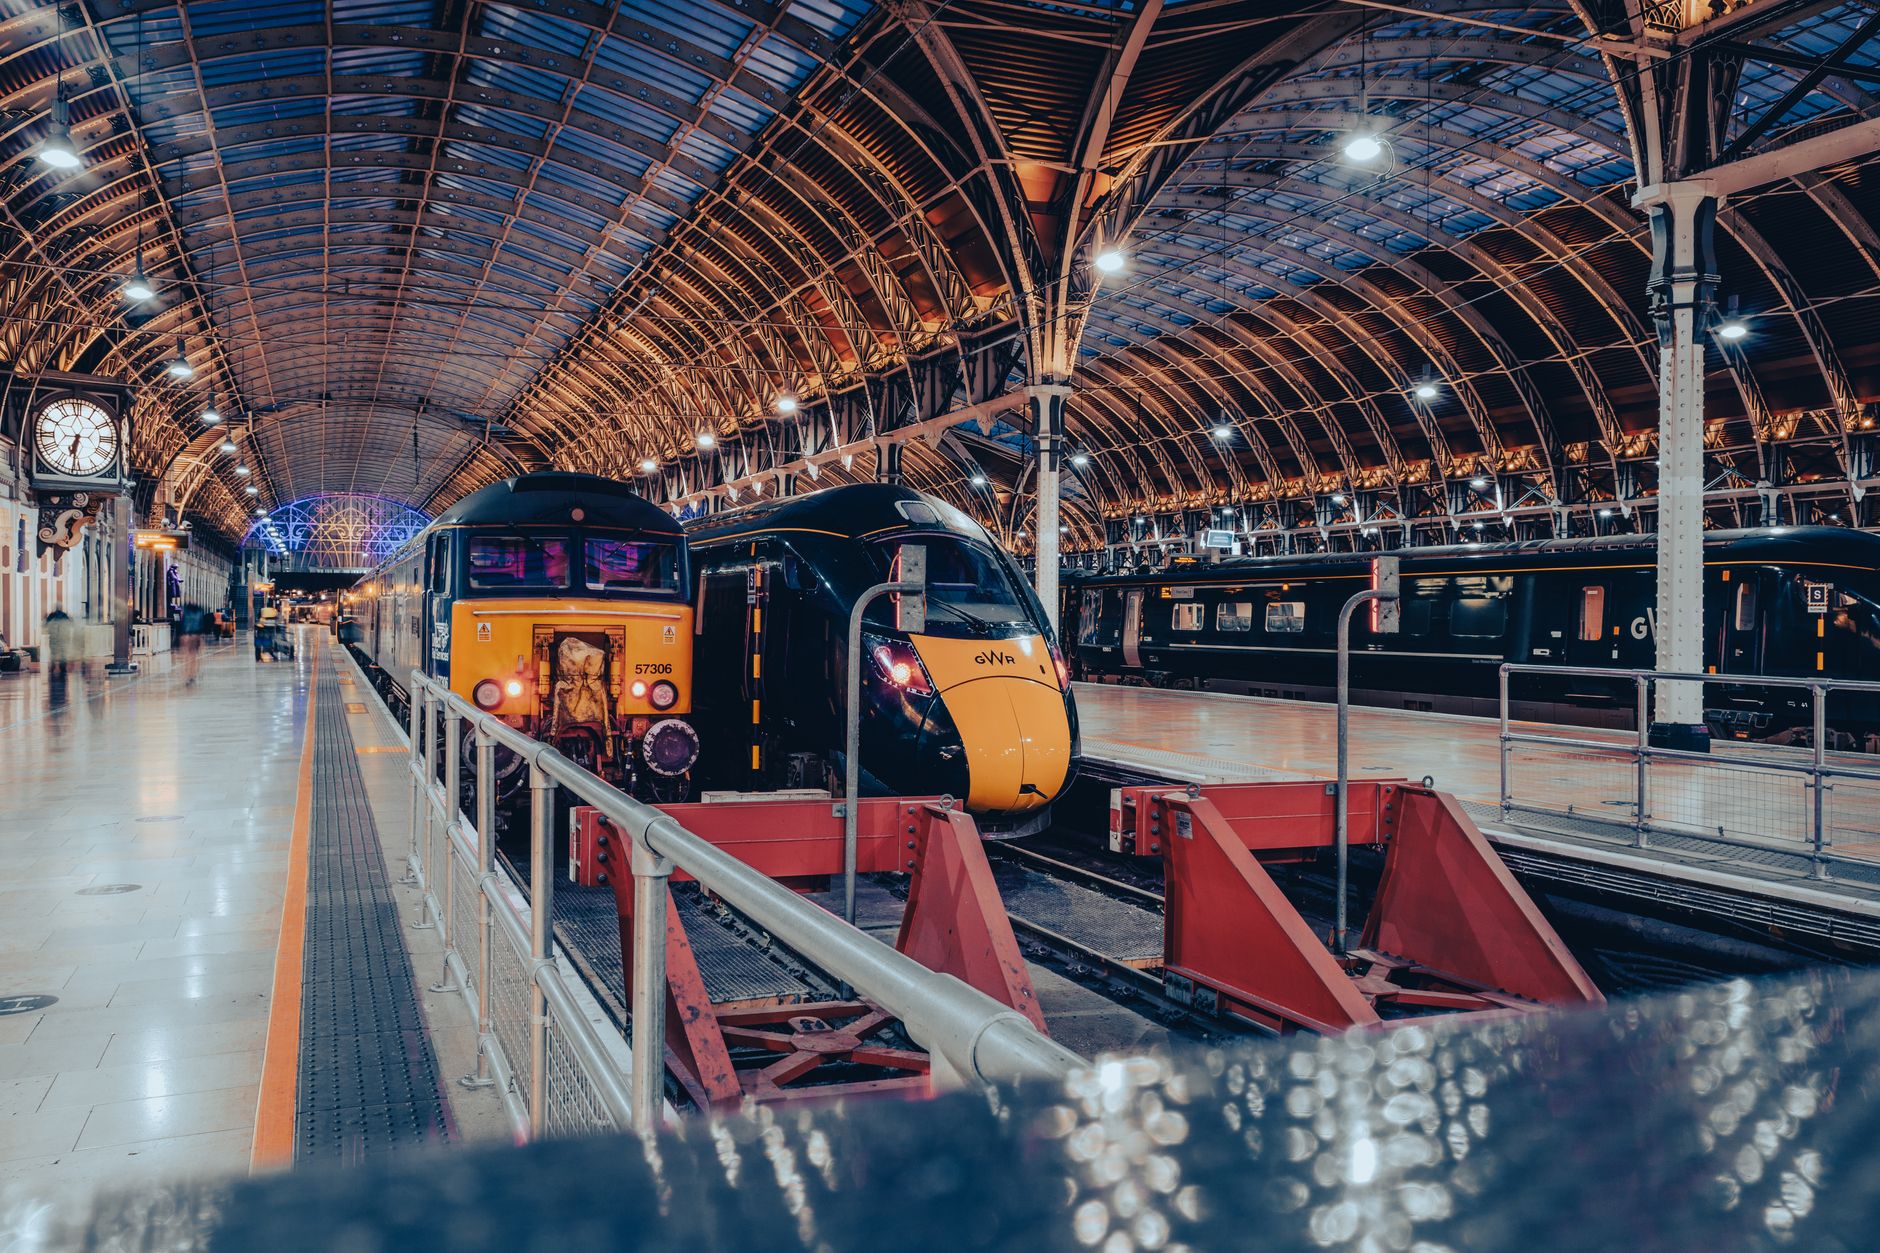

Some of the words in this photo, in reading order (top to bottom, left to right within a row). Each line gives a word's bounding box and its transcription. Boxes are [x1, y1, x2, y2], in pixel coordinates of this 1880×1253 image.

[1813, 590, 1822, 600] S
[974, 649, 1016, 666] GWR
[634, 663, 673, 675] 57306
